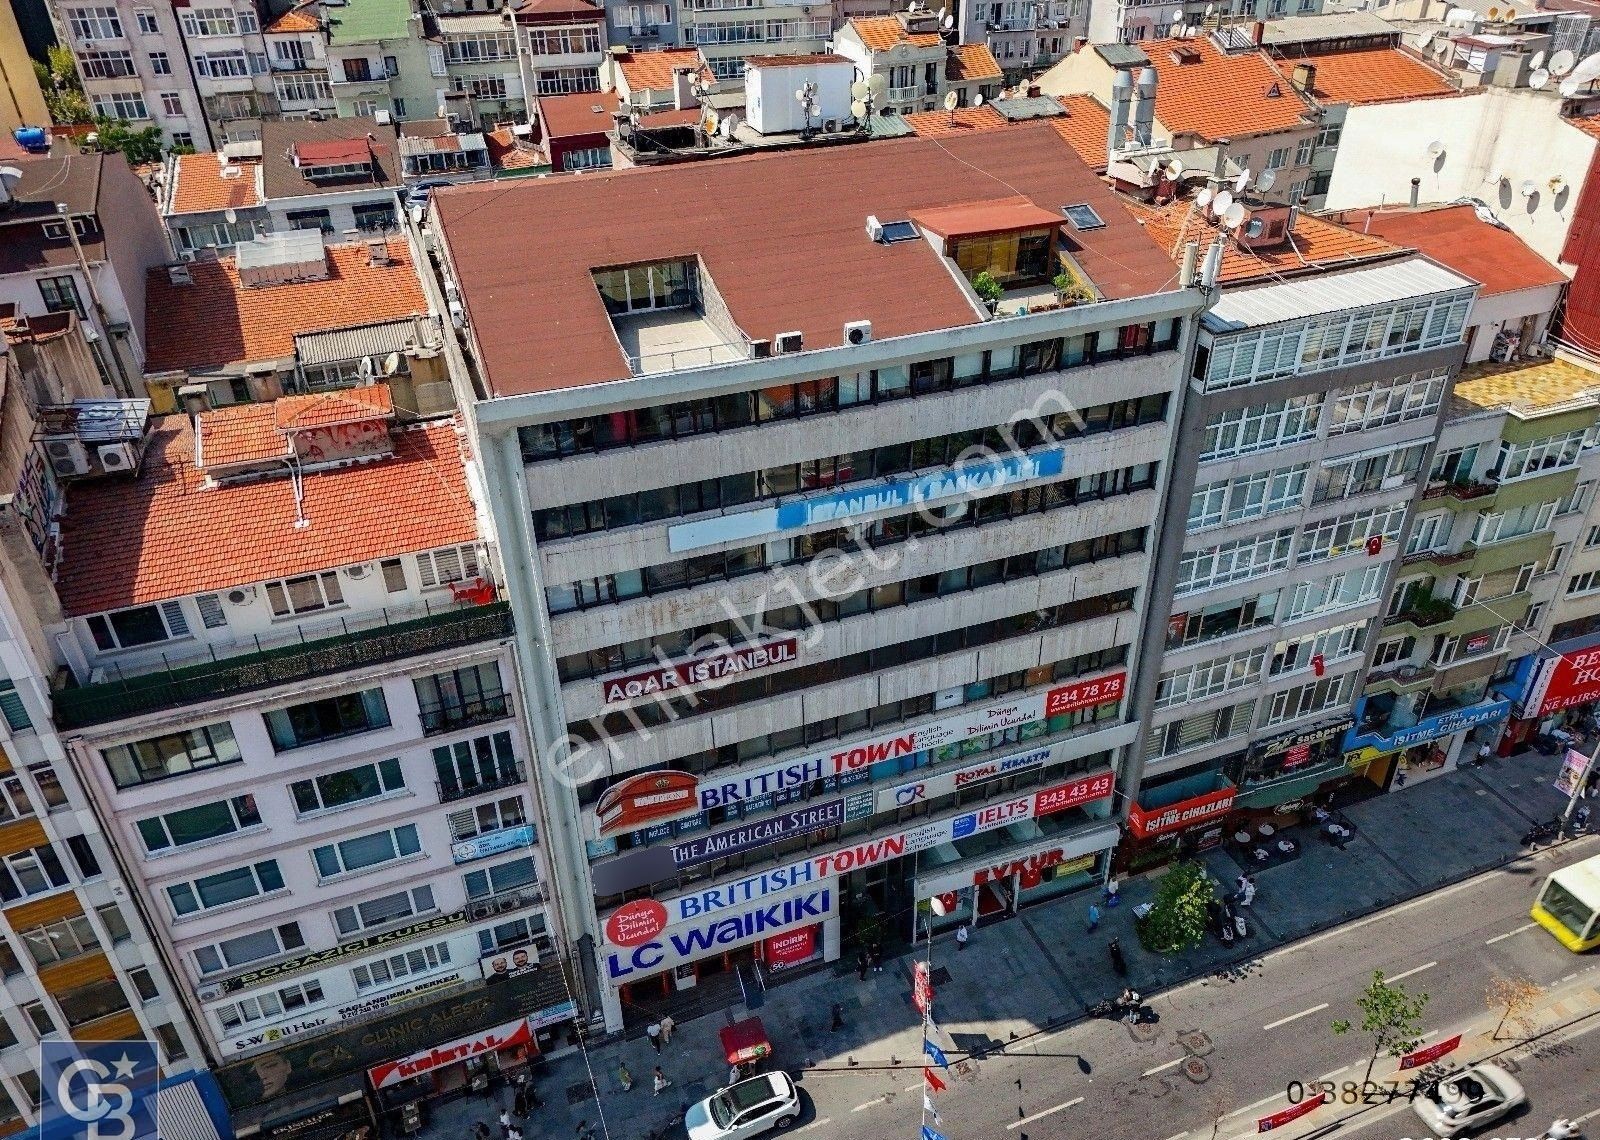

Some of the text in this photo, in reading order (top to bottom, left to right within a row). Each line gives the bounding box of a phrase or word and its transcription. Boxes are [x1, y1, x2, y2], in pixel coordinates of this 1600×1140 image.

[607, 671, 679, 703] AQAR
[1051, 678, 1120, 707] 234 78 78
[987, 706, 1018, 719] Dünya
[1542, 700, 1560, 713] NE
[914, 725, 942, 738] English
[914, 730, 954, 745] Language
[967, 722, 999, 736] Dilimin
[701, 758, 823, 810] BRITISH
[831, 732, 914, 774] TOWN
[954, 750, 1050, 786] ROYAL HEALTH
[1039, 778, 1109, 807] 343 43 43
[670, 845, 699, 863] THE
[705, 819, 784, 855] AMERICAN
[791, 803, 842, 830] STREET
[906, 825, 936, 840] English
[906, 829, 947, 846] Language
[904, 839, 937, 853] Schools
[680, 834, 906, 920] BRITISH TOWN
[617, 908, 655, 924] Dünya
[378, 912, 464, 943] KURSU
[617, 917, 656, 933] Dilimin
[618, 921, 660, 942] Ucunda!
[608, 942, 665, 979] LC
[293, 1017, 328, 1033] Hair
